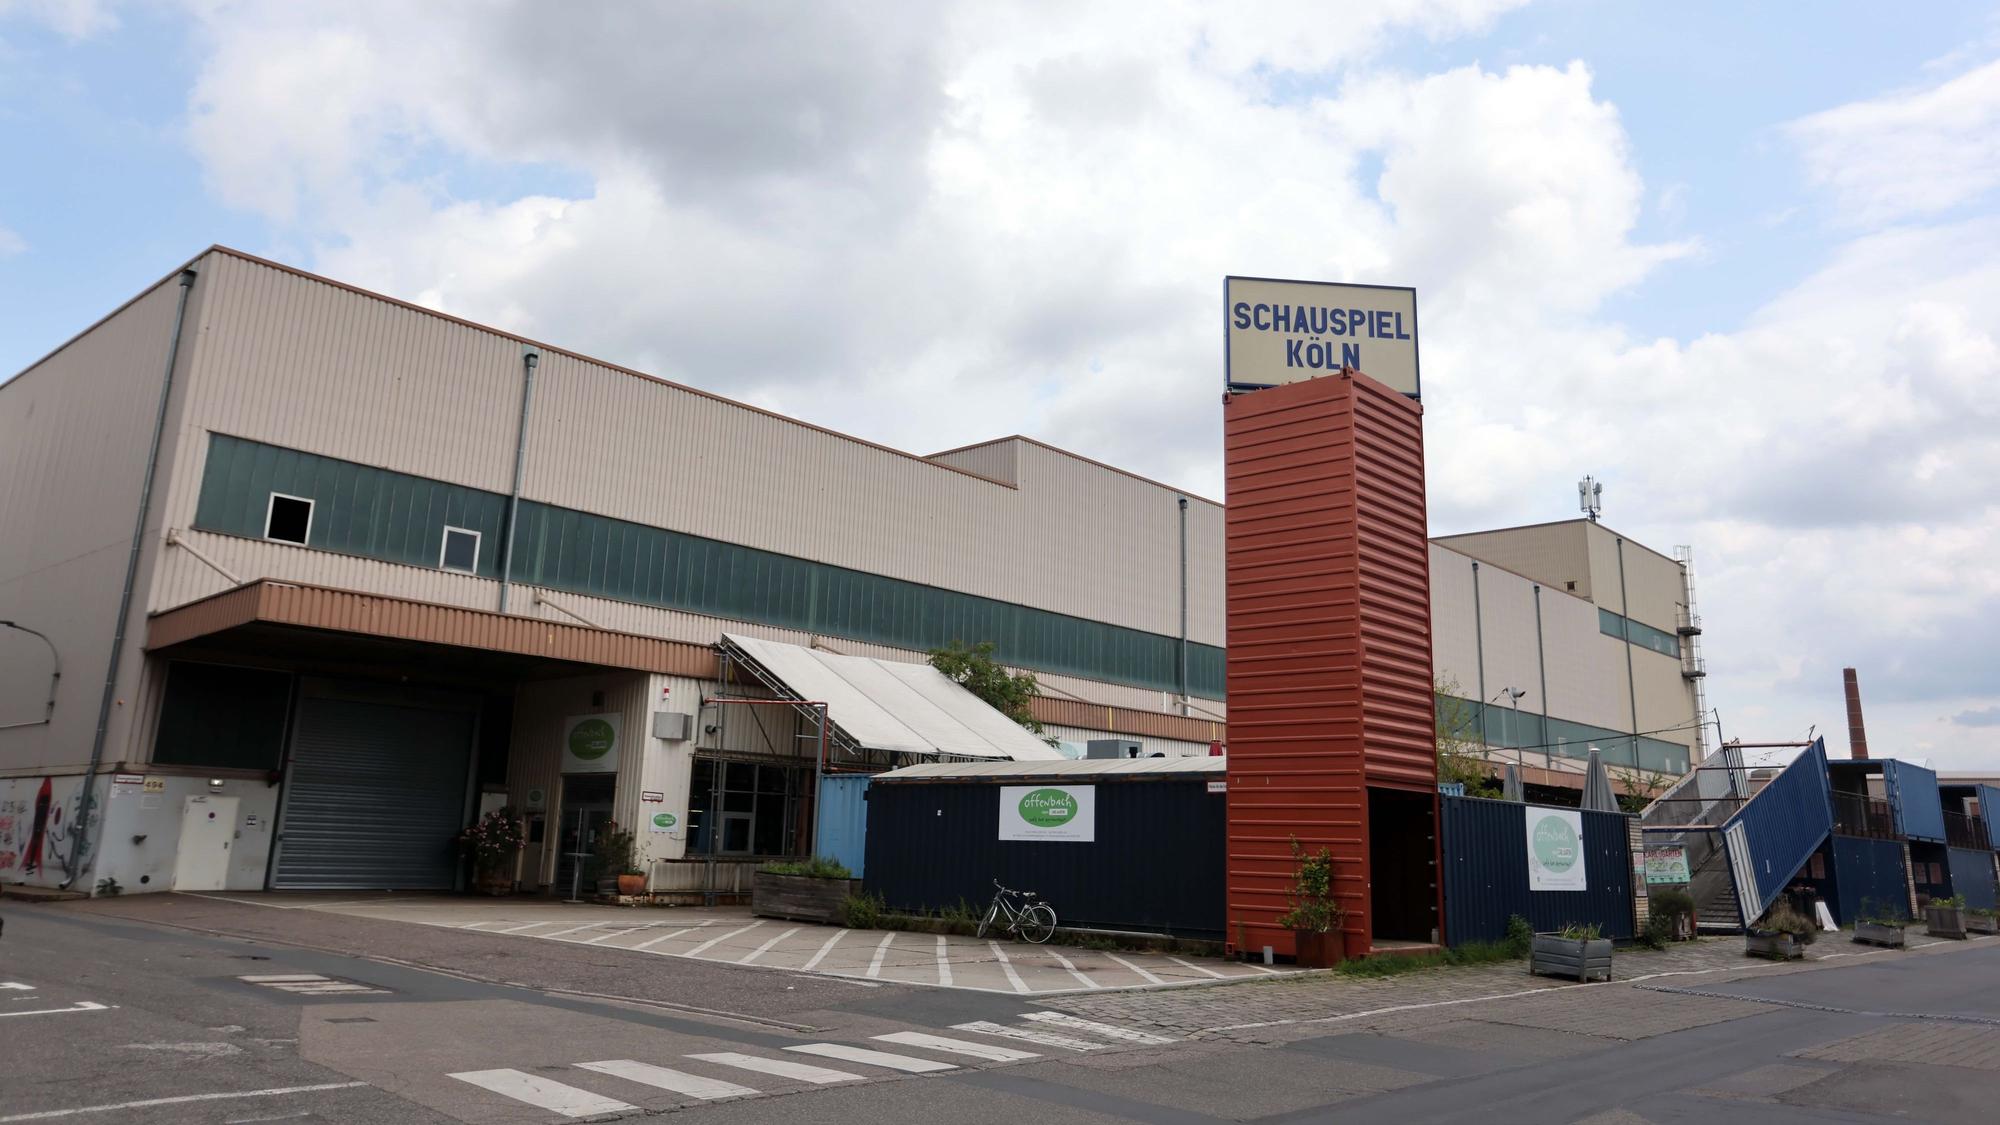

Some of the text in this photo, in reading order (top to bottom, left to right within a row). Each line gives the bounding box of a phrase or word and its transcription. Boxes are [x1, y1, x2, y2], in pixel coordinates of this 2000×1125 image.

[1233, 301, 1411, 340] SCHAUSPIEL
[1286, 336, 1361, 371] KÖLN
[1024, 793, 1072, 808] offenbach
